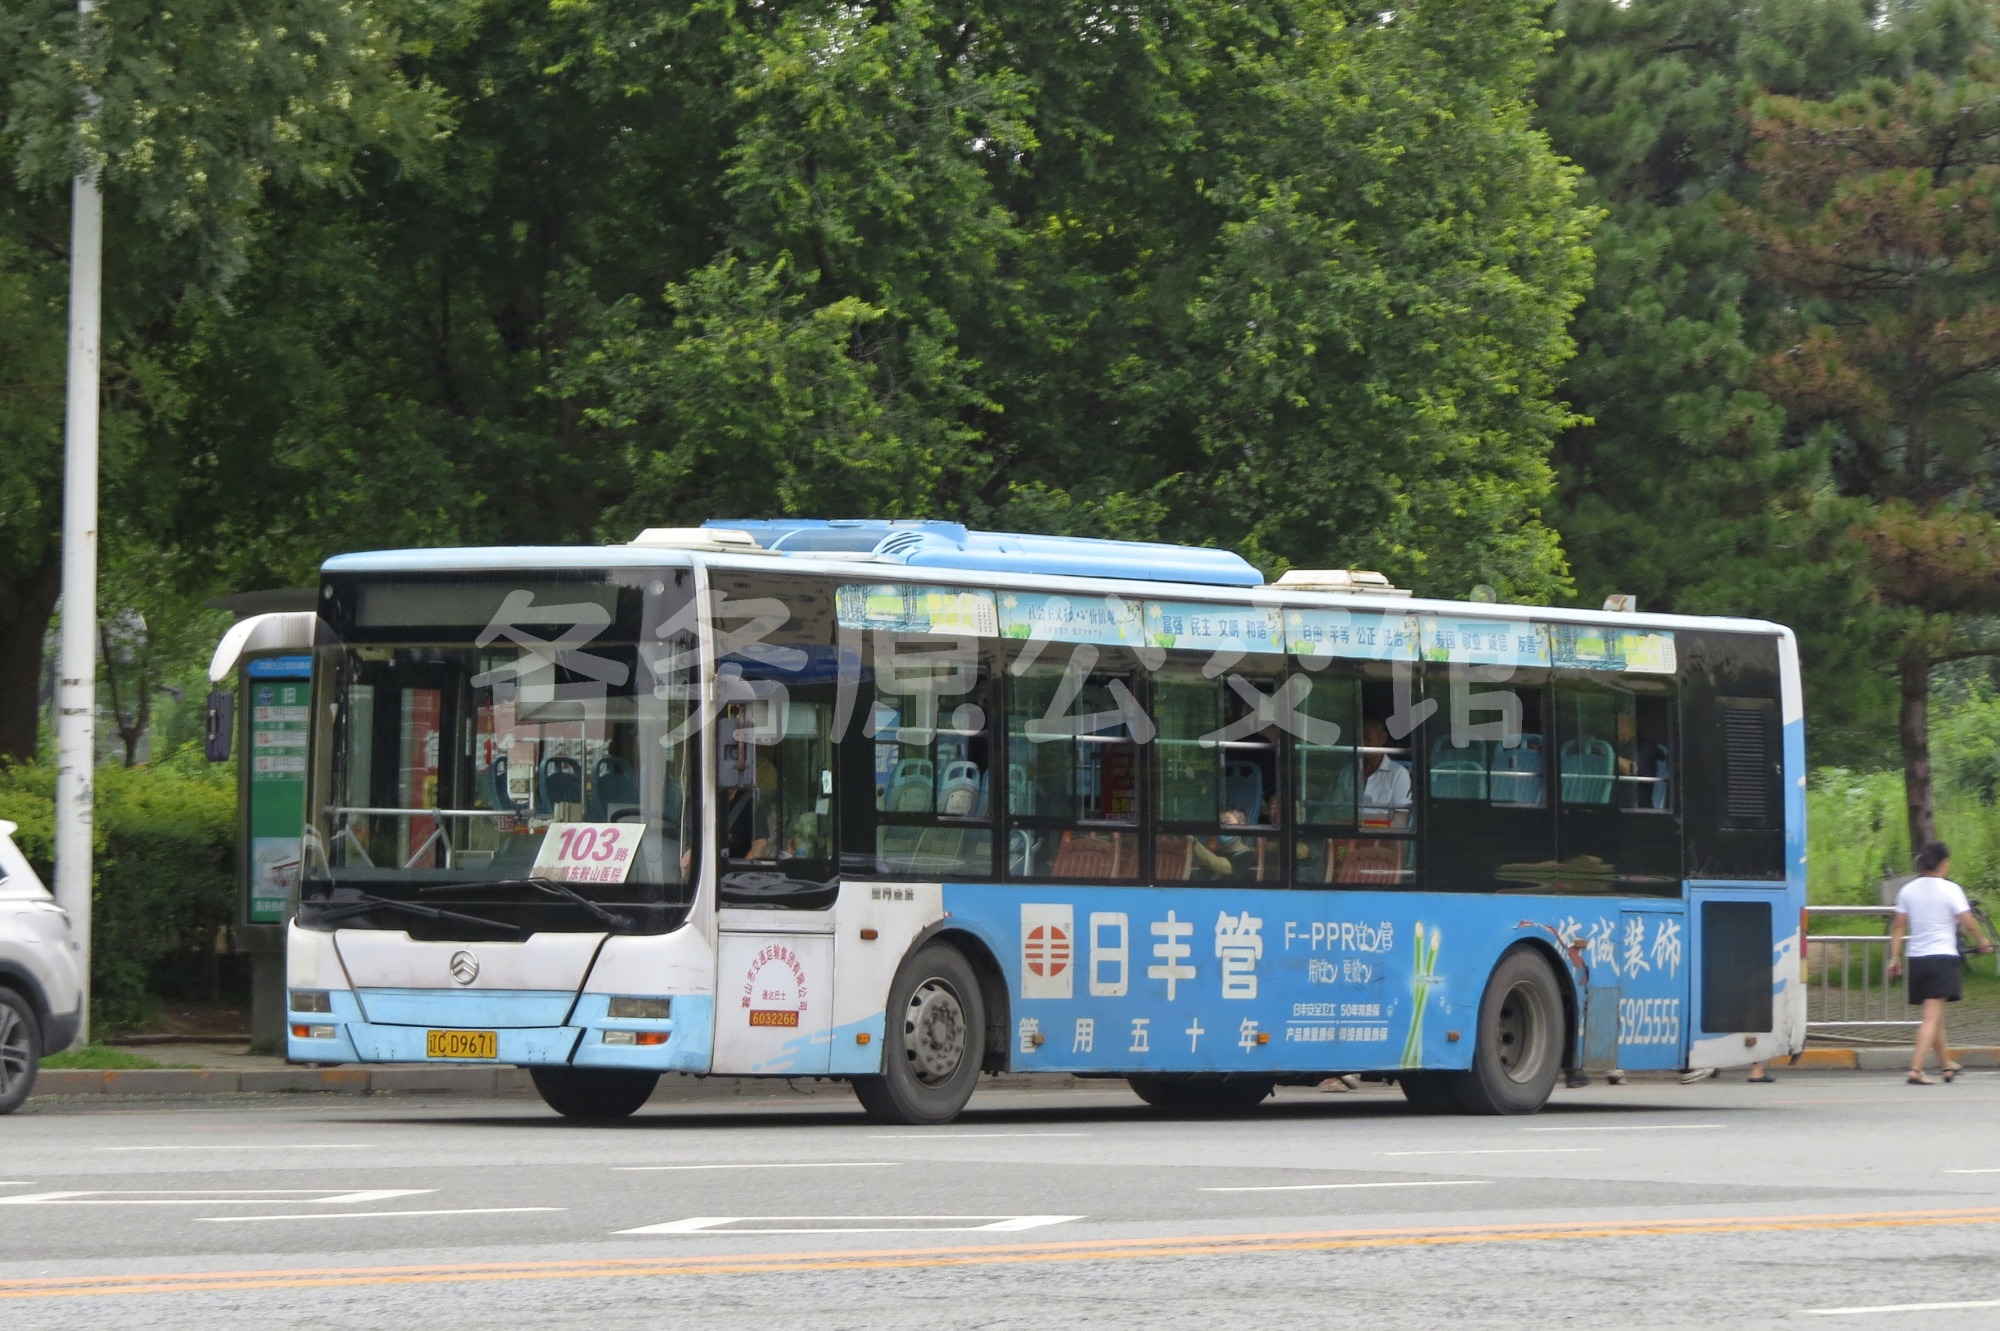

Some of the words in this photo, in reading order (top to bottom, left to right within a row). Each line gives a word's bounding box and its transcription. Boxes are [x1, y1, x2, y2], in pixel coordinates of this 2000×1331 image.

[1163, 616, 1183, 635] 富强
[1191, 617, 1211, 636] 民主
[1219, 618, 1240, 638] 文明
[1246, 620, 1267, 640] 和谐
[1303, 624, 1323, 642] 自由
[1330, 625, 1350, 644] 平等
[1357, 626, 1376, 646] 公正
[1383, 629, 1404, 647] 法治
[1435, 630, 1456, 649] 爱国
[1462, 632, 1482, 651] 敬业
[1488, 633, 1508, 652] 诚信
[1517, 635, 1537, 654] 友善
[1089, 910, 1263, 1001] 日丰管
[753, 1012, 796, 1025] 6032266
[1019, 1017, 1260, 1054] 管用五十年
